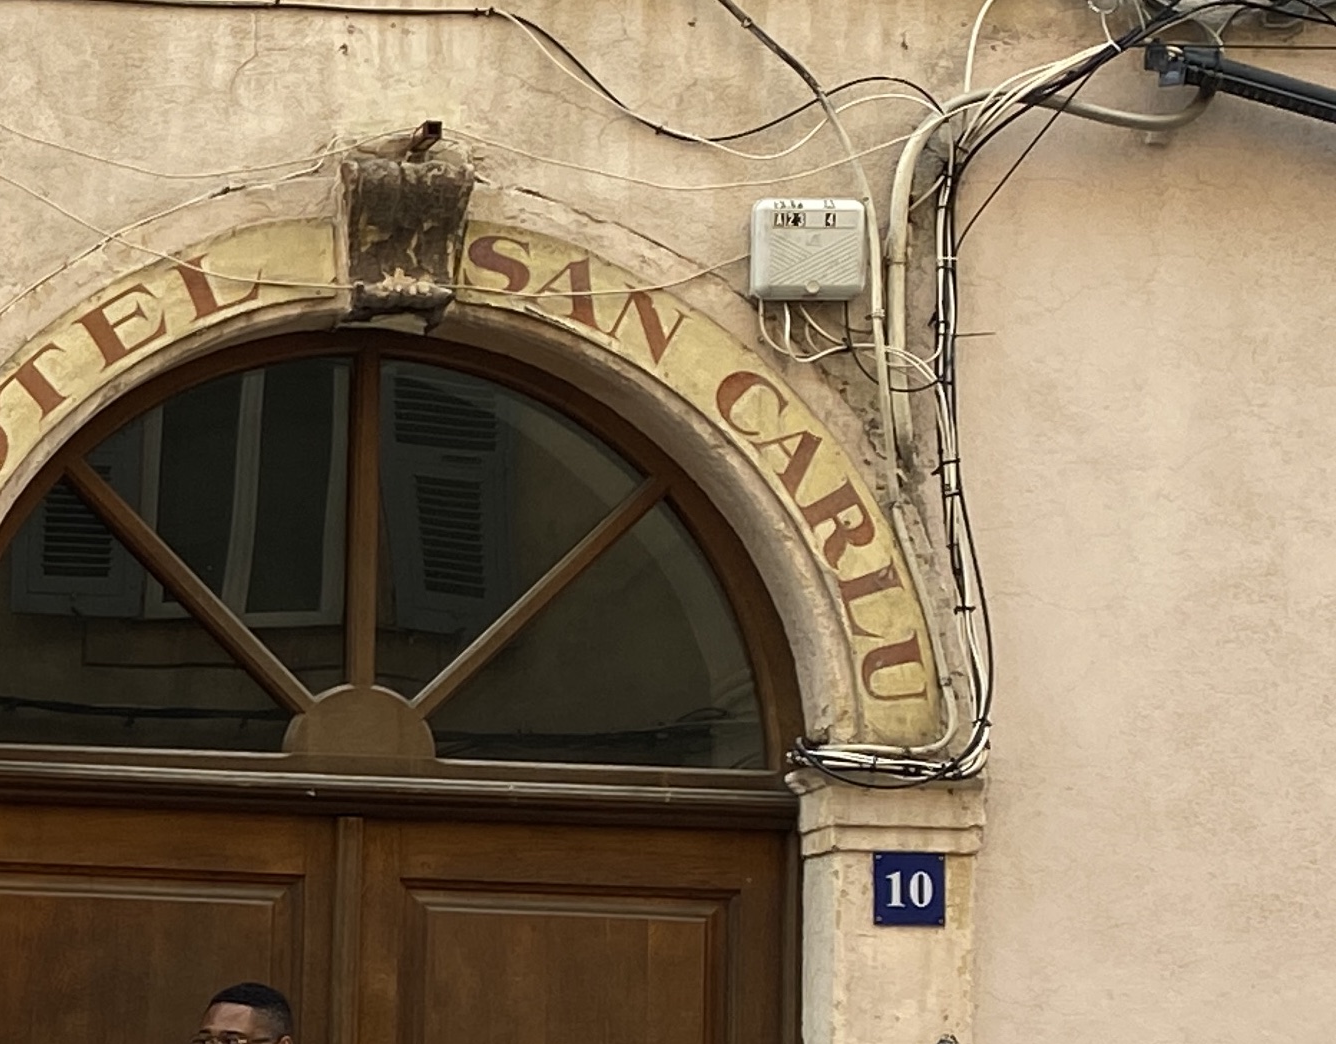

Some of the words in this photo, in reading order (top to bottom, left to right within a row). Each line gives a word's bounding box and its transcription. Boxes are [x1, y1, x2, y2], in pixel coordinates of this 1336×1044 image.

[463, 235, 691, 366] SAN
[715, 370, 928, 702] CARLU
[885, 871, 934, 908] 10
